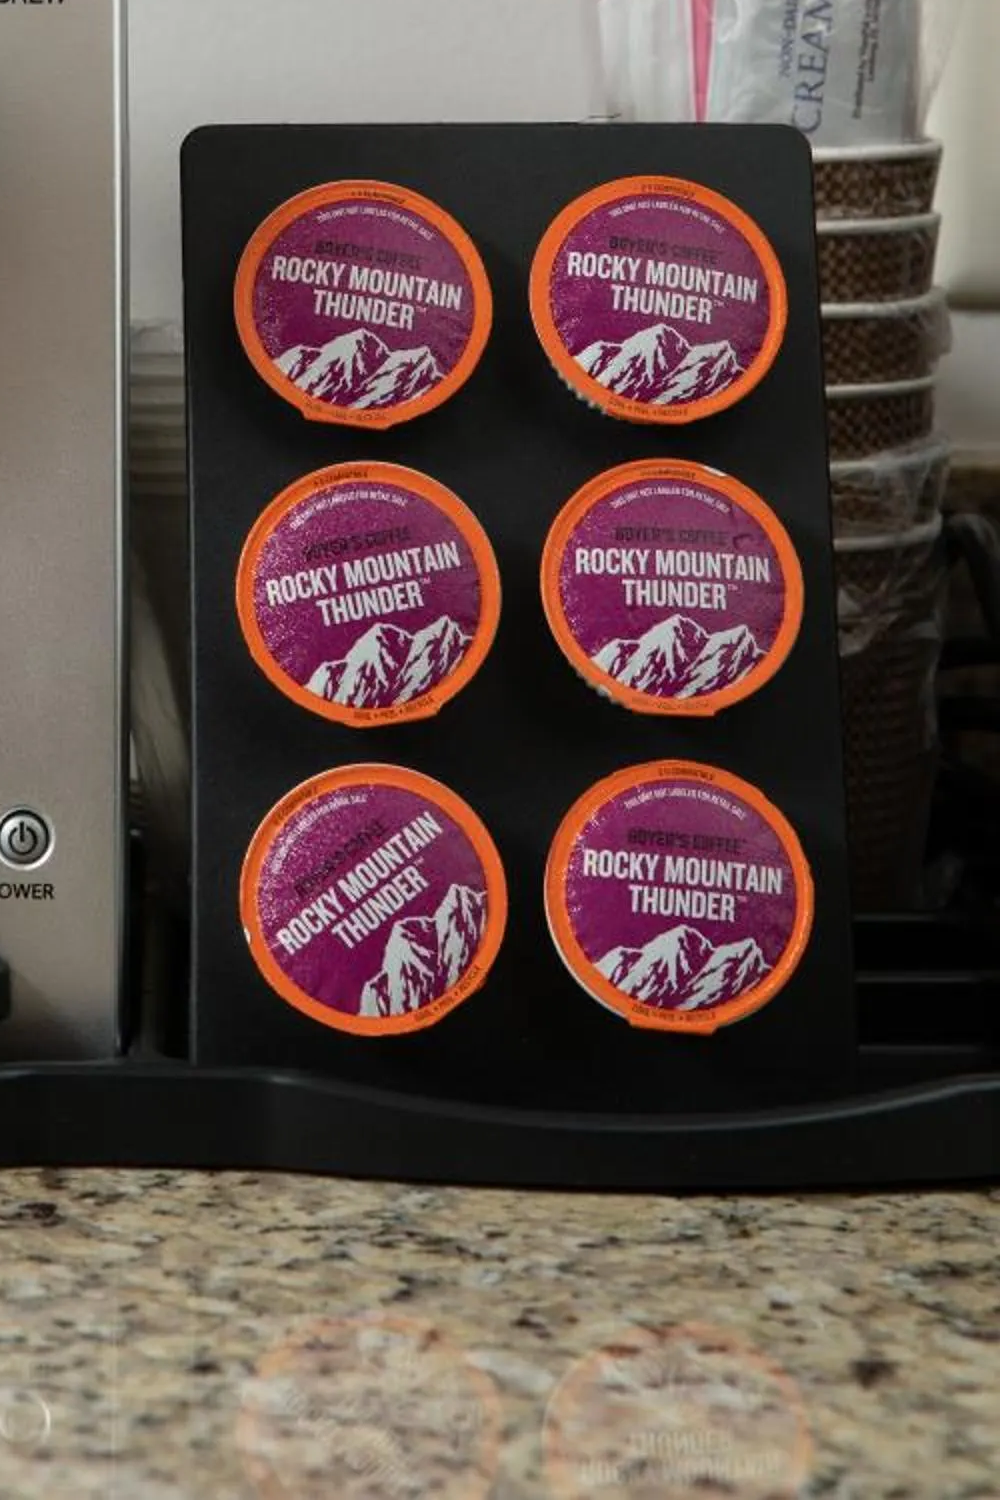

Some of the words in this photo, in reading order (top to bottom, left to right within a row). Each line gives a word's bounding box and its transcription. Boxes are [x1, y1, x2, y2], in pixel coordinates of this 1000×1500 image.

[271, 255, 346, 288] ROCKY
[349, 264, 463, 311] MOUNTAIN
[567, 251, 642, 283] ROCKY
[646, 259, 758, 304] MOUNTAIN
[265, 565, 341, 607] ROCKY
[343, 541, 462, 589] MOUNTAIN
[575, 548, 650, 575] ROCKY
[655, 549, 771, 583] MOUNTAIN
[275, 885, 344, 956] ROCKY
[337, 811, 443, 904] MOUNTAIN
[582, 849, 658, 882] ROCKY
[663, 855, 783, 895] MOUNTAIN
